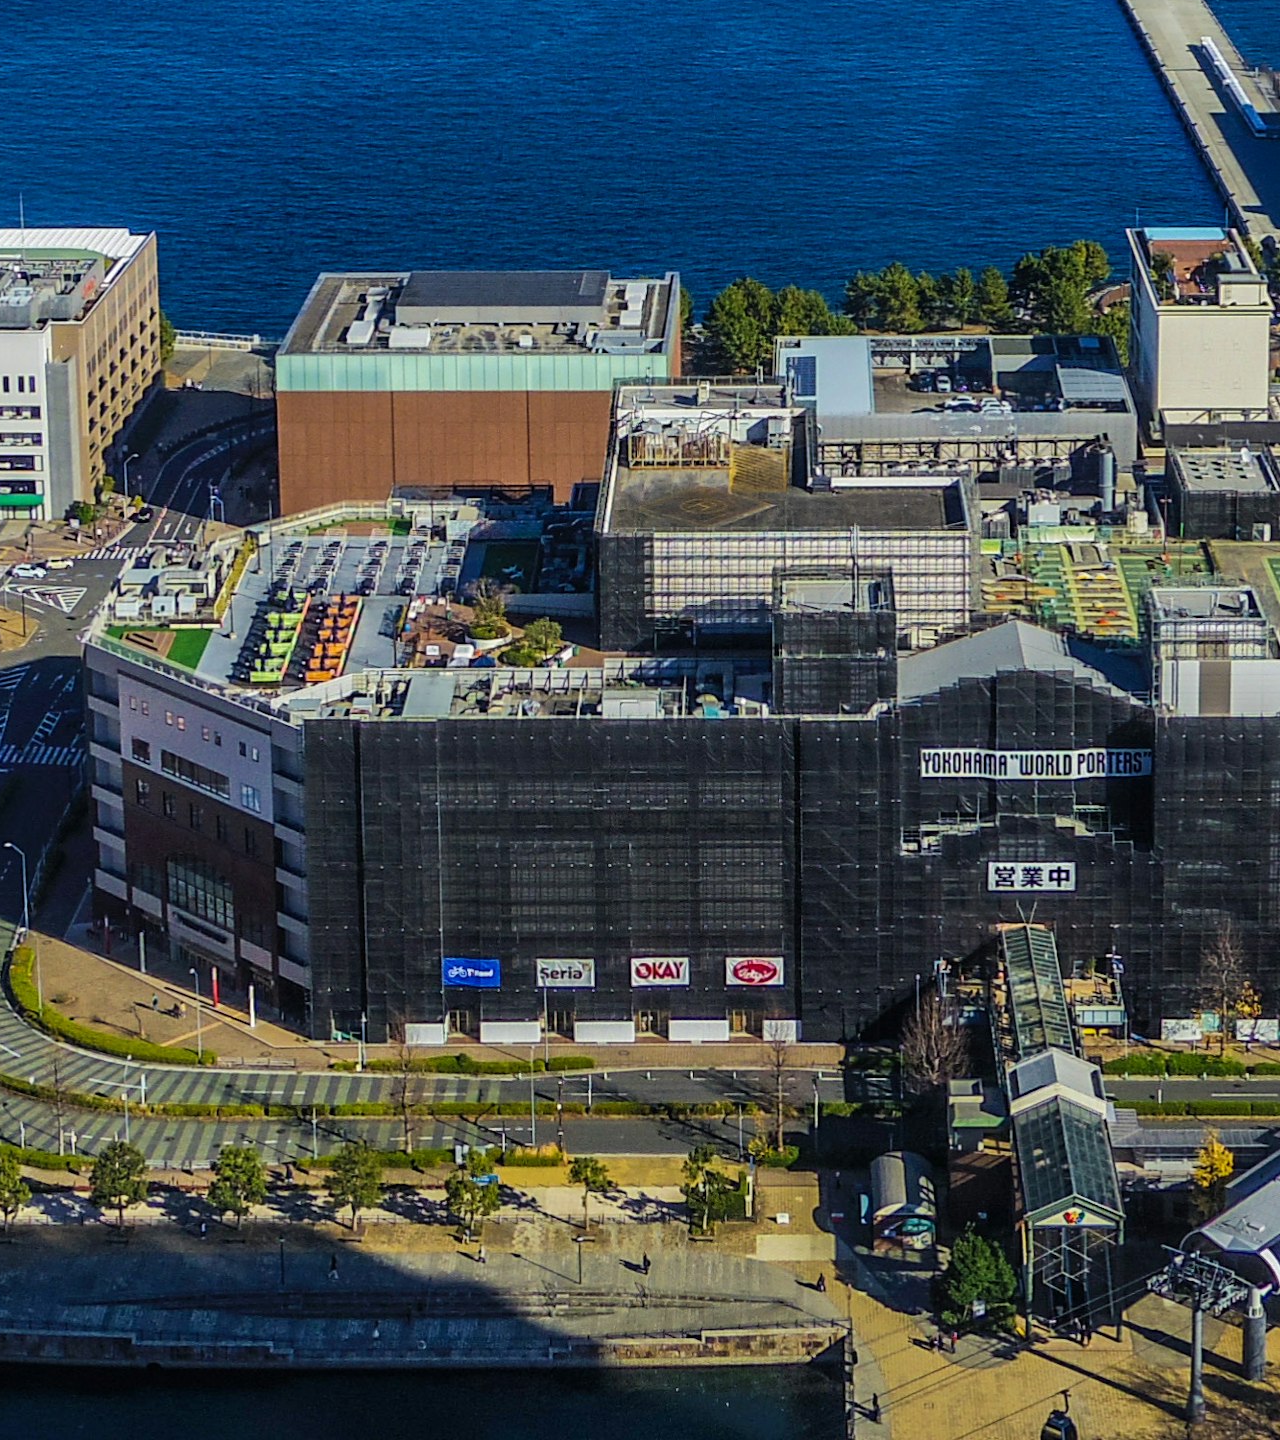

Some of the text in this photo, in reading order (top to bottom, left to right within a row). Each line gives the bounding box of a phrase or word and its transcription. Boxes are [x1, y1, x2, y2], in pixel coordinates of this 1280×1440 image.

[922, 752, 1008, 776] YOKOHAMA
[994, 866, 1071, 888] 営業中
[540, 966, 583, 980] Seria
[635, 961, 684, 980] OKAY
